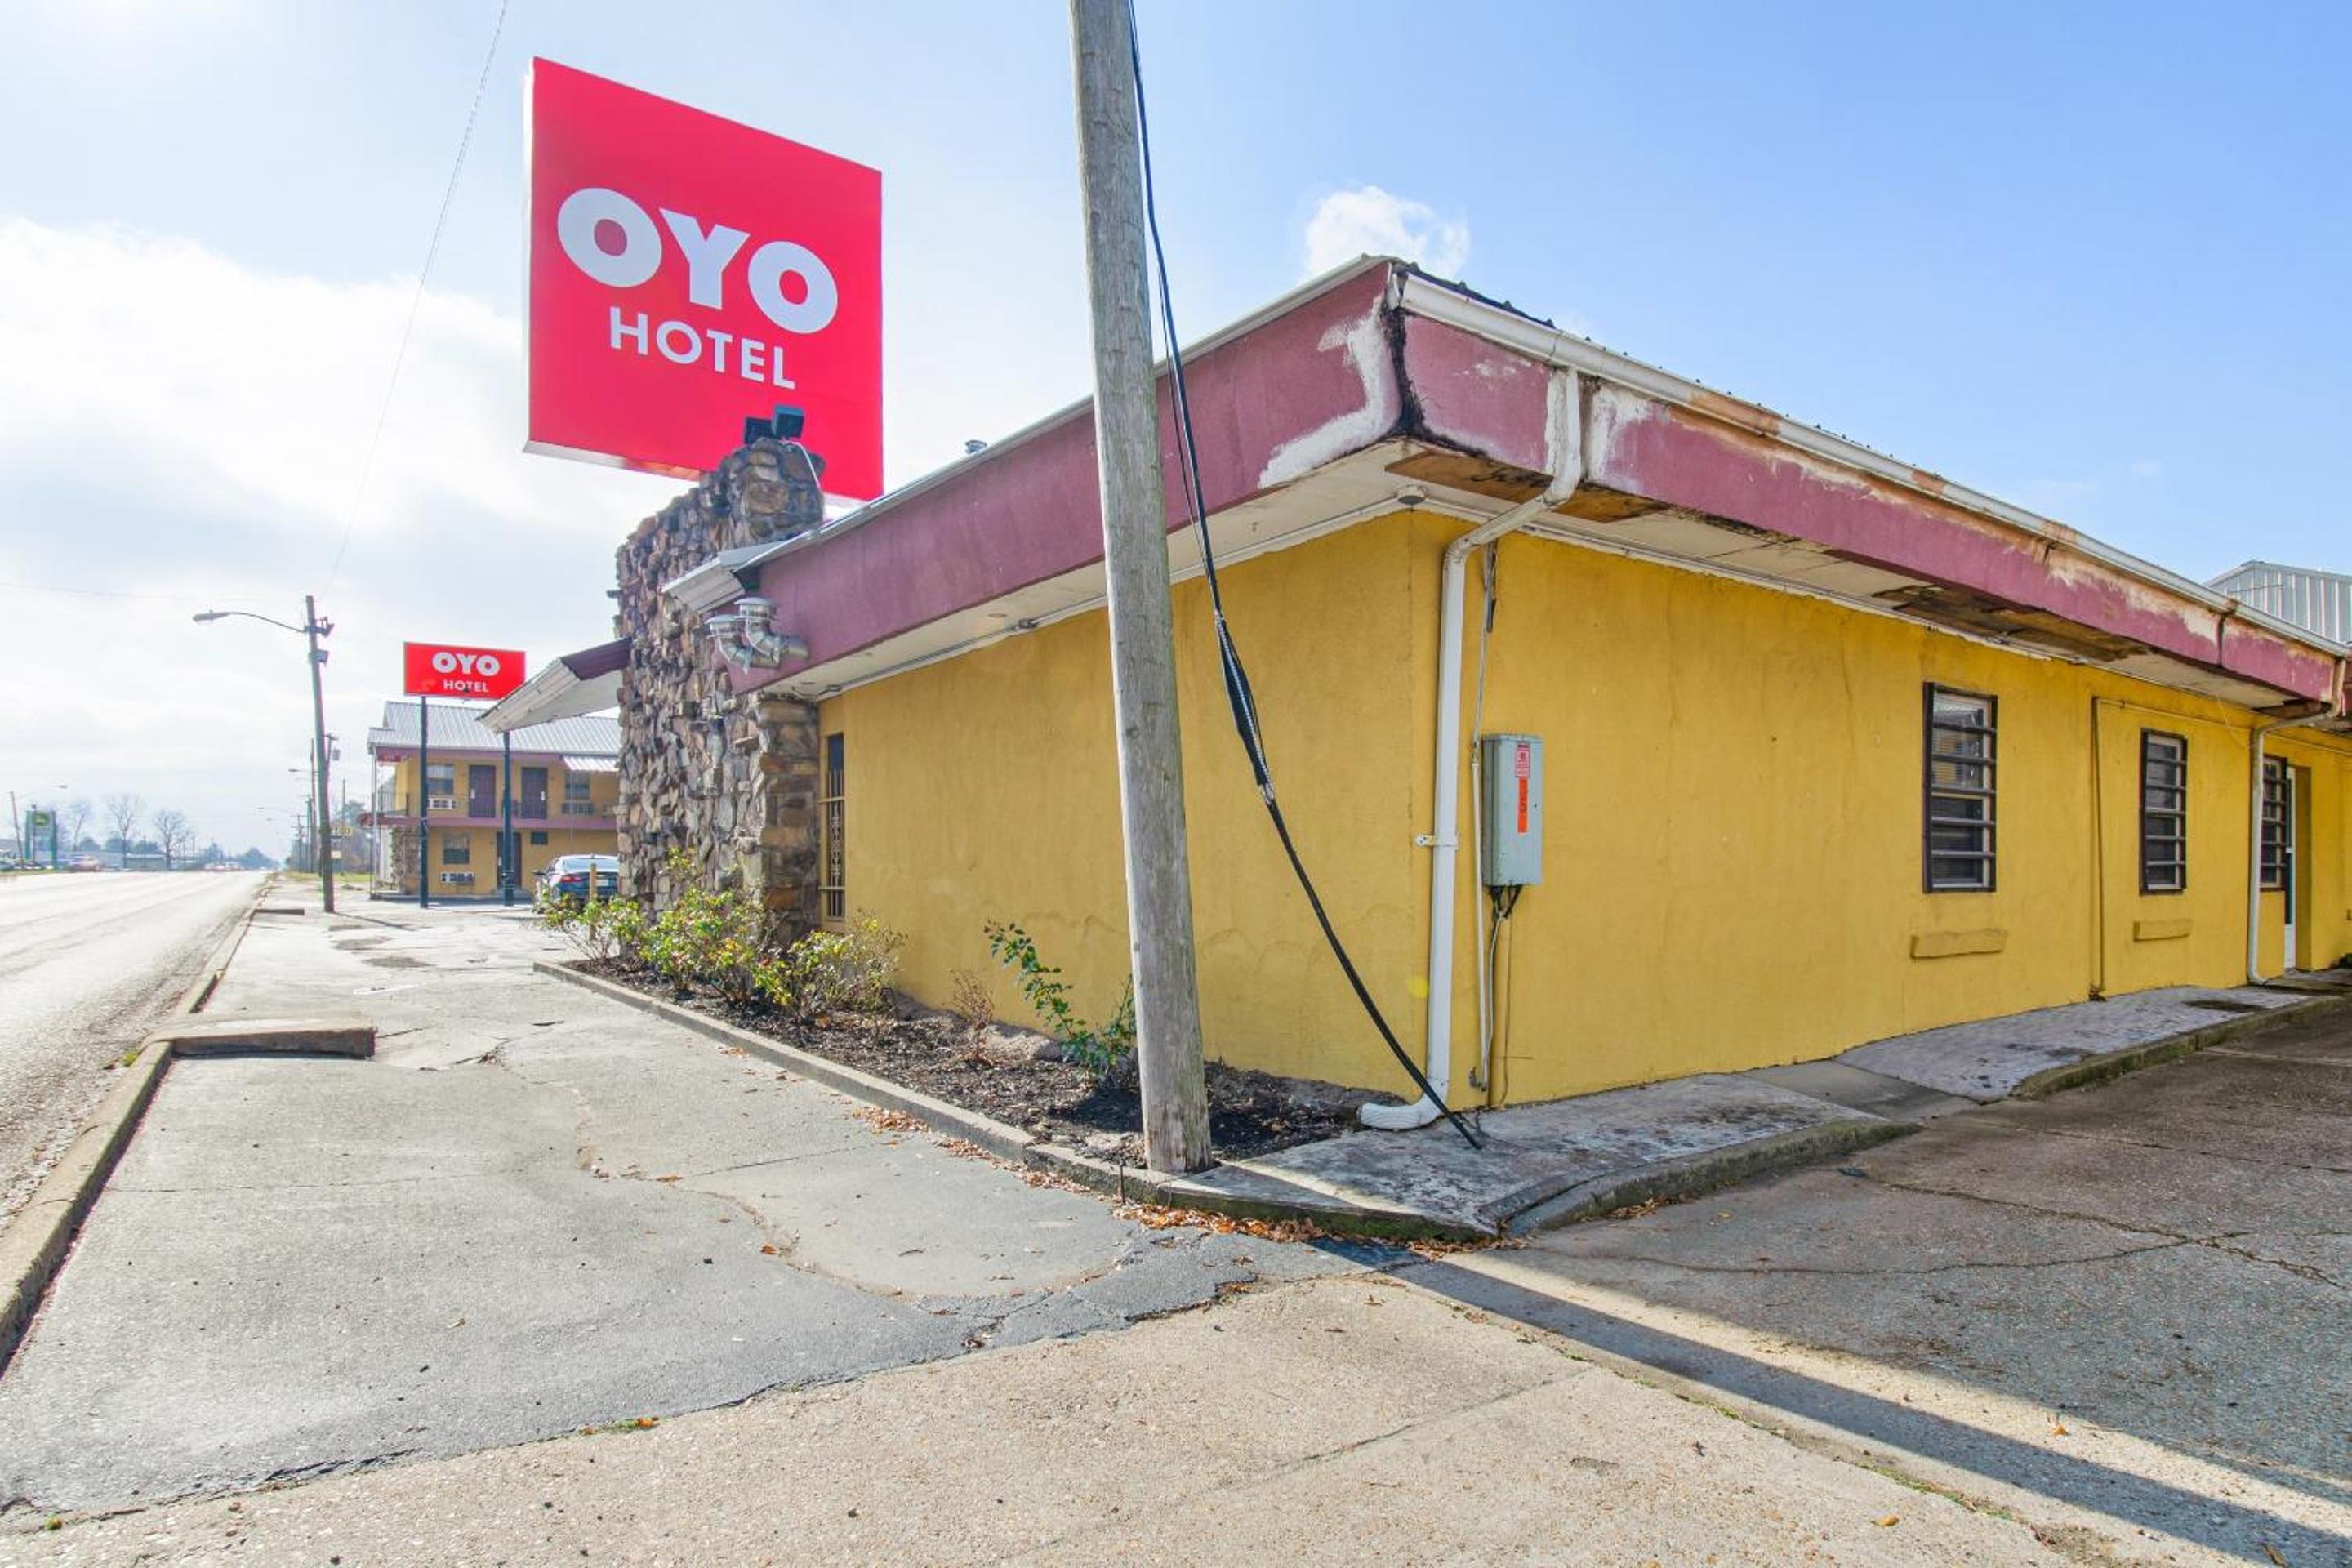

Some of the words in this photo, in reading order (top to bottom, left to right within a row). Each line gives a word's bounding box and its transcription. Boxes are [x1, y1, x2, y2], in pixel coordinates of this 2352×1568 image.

[558, 187, 838, 334] OYO
[610, 307, 796, 389] HOTEL
[432, 652, 500, 676] OYO
[443, 679, 489, 693] HOTEL
